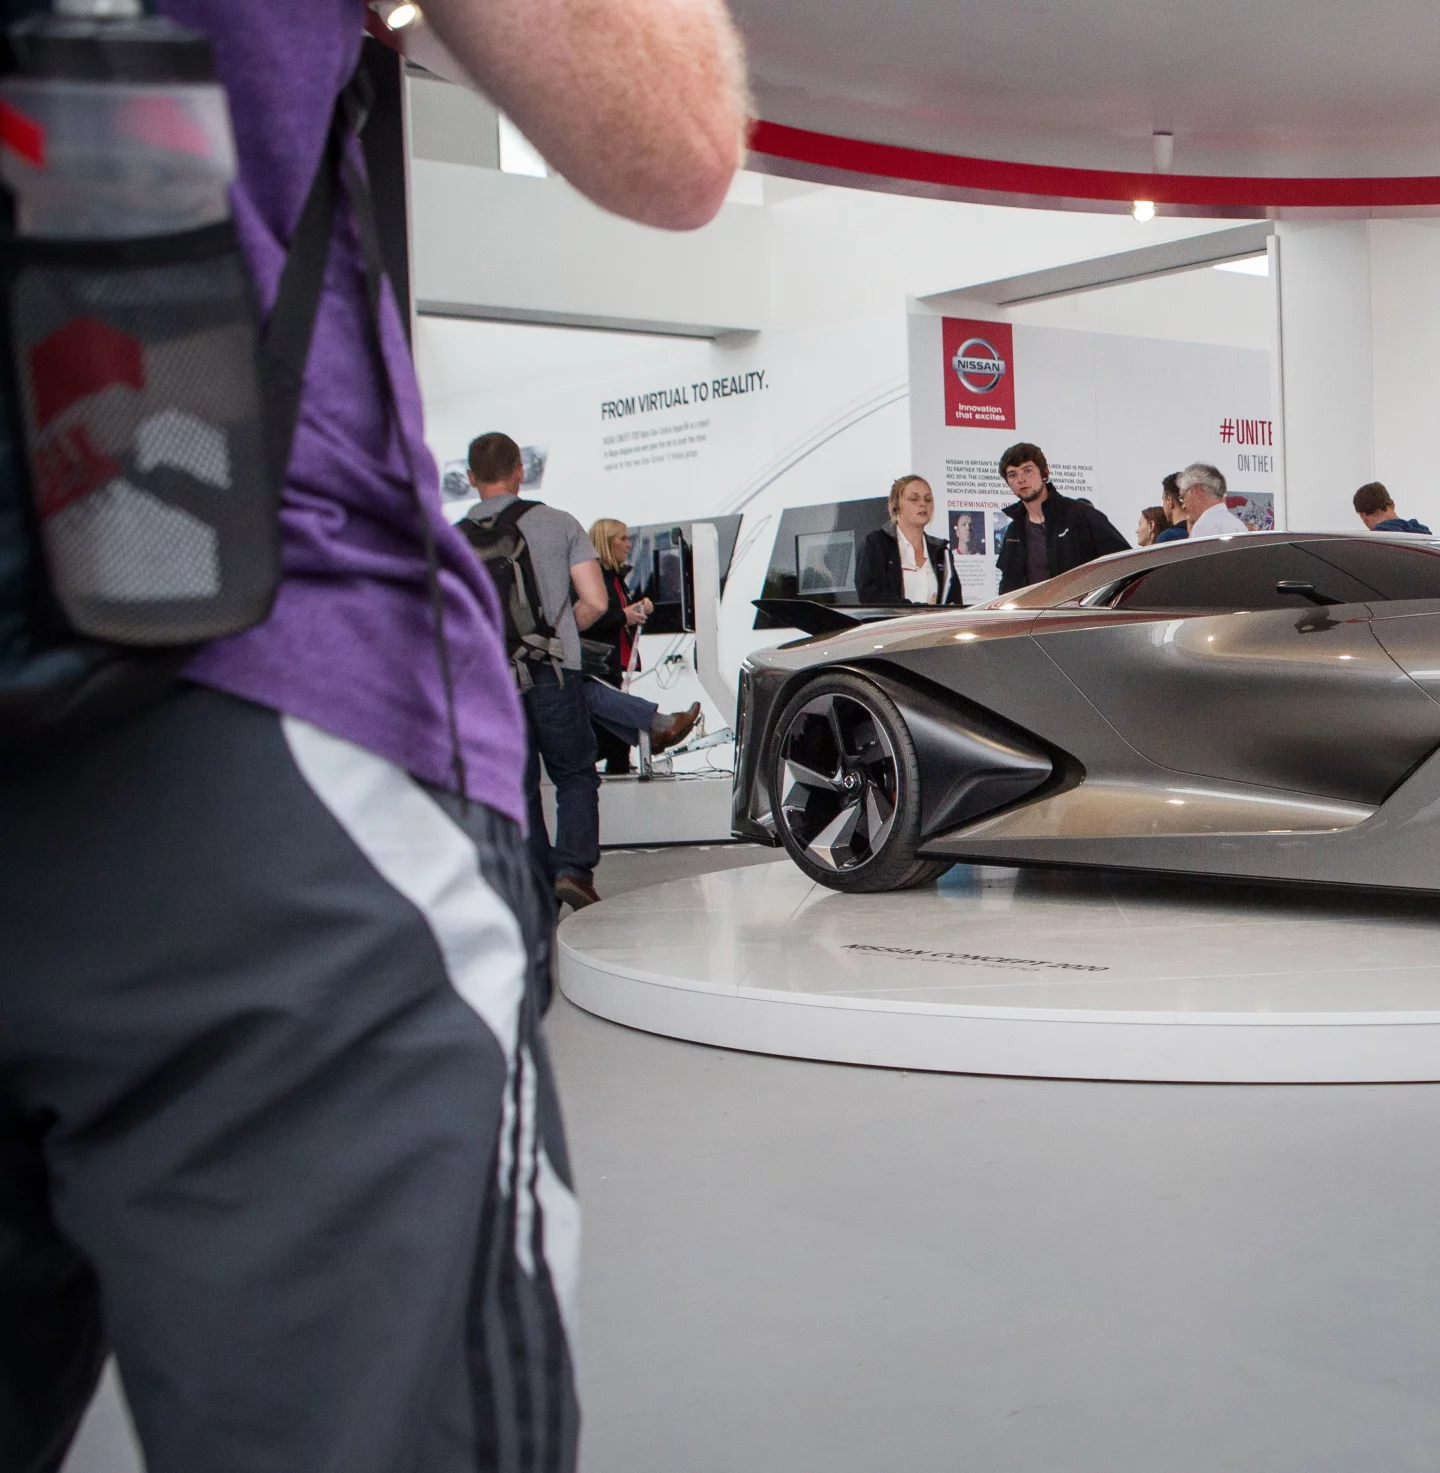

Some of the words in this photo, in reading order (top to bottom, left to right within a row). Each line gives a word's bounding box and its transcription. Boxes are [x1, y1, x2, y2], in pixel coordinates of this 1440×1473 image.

[957, 360, 1000, 371] NISSAN
[601, 396, 635, 420] FROM
[638, 386, 689, 413] VIRTUAL
[692, 382, 709, 402] TO
[712, 369, 769, 399] REALITY.
[958, 403, 1002, 413] Innovation
[955, 411, 972, 419] that
[975, 413, 1006, 421] excites
[1219, 418, 1272, 446] #UNITE
[1237, 454, 1250, 472] ON
[1252, 455, 1268, 472] THE
[947, 500, 1000, 509] DETERMINATION,
[931, 952, 1051, 966] CONCEPT
